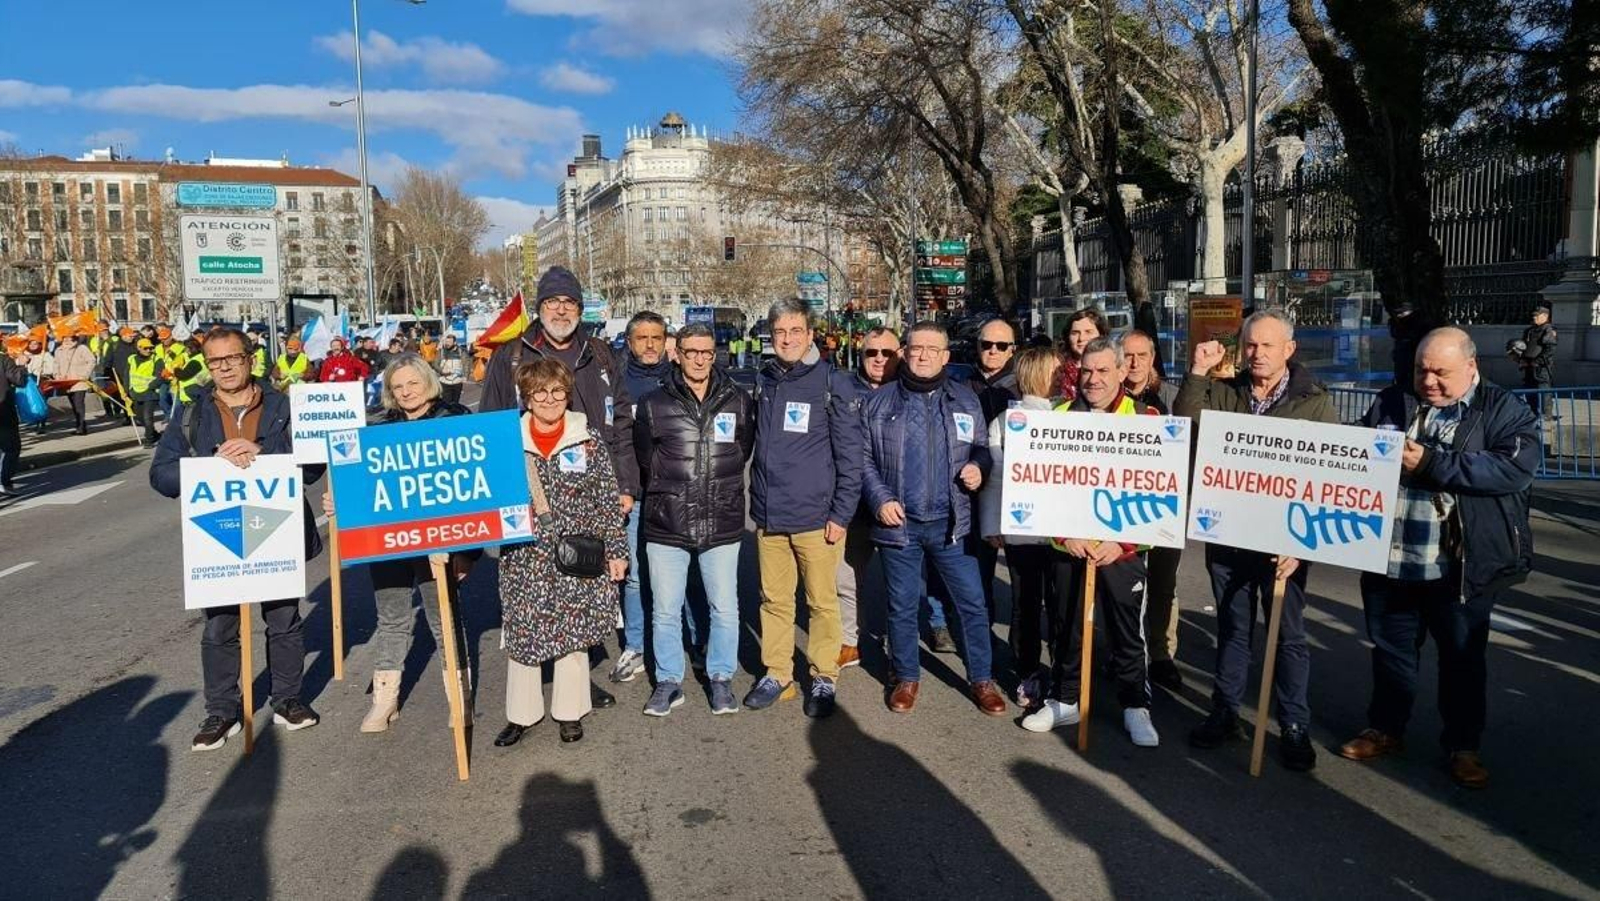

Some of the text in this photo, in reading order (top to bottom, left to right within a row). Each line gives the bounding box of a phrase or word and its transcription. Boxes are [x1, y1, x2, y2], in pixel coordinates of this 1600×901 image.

[203, 185, 273, 194] Distrito Centro
[188, 220, 270, 230] ATENCIÓN
[227, 261, 260, 269] Atocha
[308, 394, 346, 402] POR LA
[298, 409, 357, 421] SOBERANÍA
[332, 433, 357, 442] ARVI
[1030, 428, 1162, 445] O FUTURO DA PESCA
[1045, 443, 1079, 452] FUTURO
[1096, 446, 1116, 454] VIGO
[1126, 448, 1162, 457] GALICIA
[1225, 431, 1369, 460] O FUTURO DA PESCA
[366, 434, 486, 474] SALVEMOS
[1223, 445, 1229, 454] É
[1240, 448, 1276, 460] FUTURO
[1279, 453, 1291, 462] DE
[1294, 456, 1316, 465] VIGO
[1319, 459, 1324, 467] E
[1327, 460, 1368, 473] GALICIA
[1011, 462, 1178, 492] SALVEMOS A PESCA
[190, 477, 296, 504] ARVI
[374, 467, 492, 512] A PESCA
[1202, 466, 1384, 513] SALVEMOS A PESCA
[502, 505, 528, 514] ARVI
[1011, 502, 1034, 510] ARVI
[1197, 507, 1222, 518] ARVI
[384, 520, 491, 548] SOS PESCA
[192, 564, 240, 574] COOPERATIVA
[254, 559, 296, 568] ARMADORES
[242, 568, 269, 576] PUERTO
